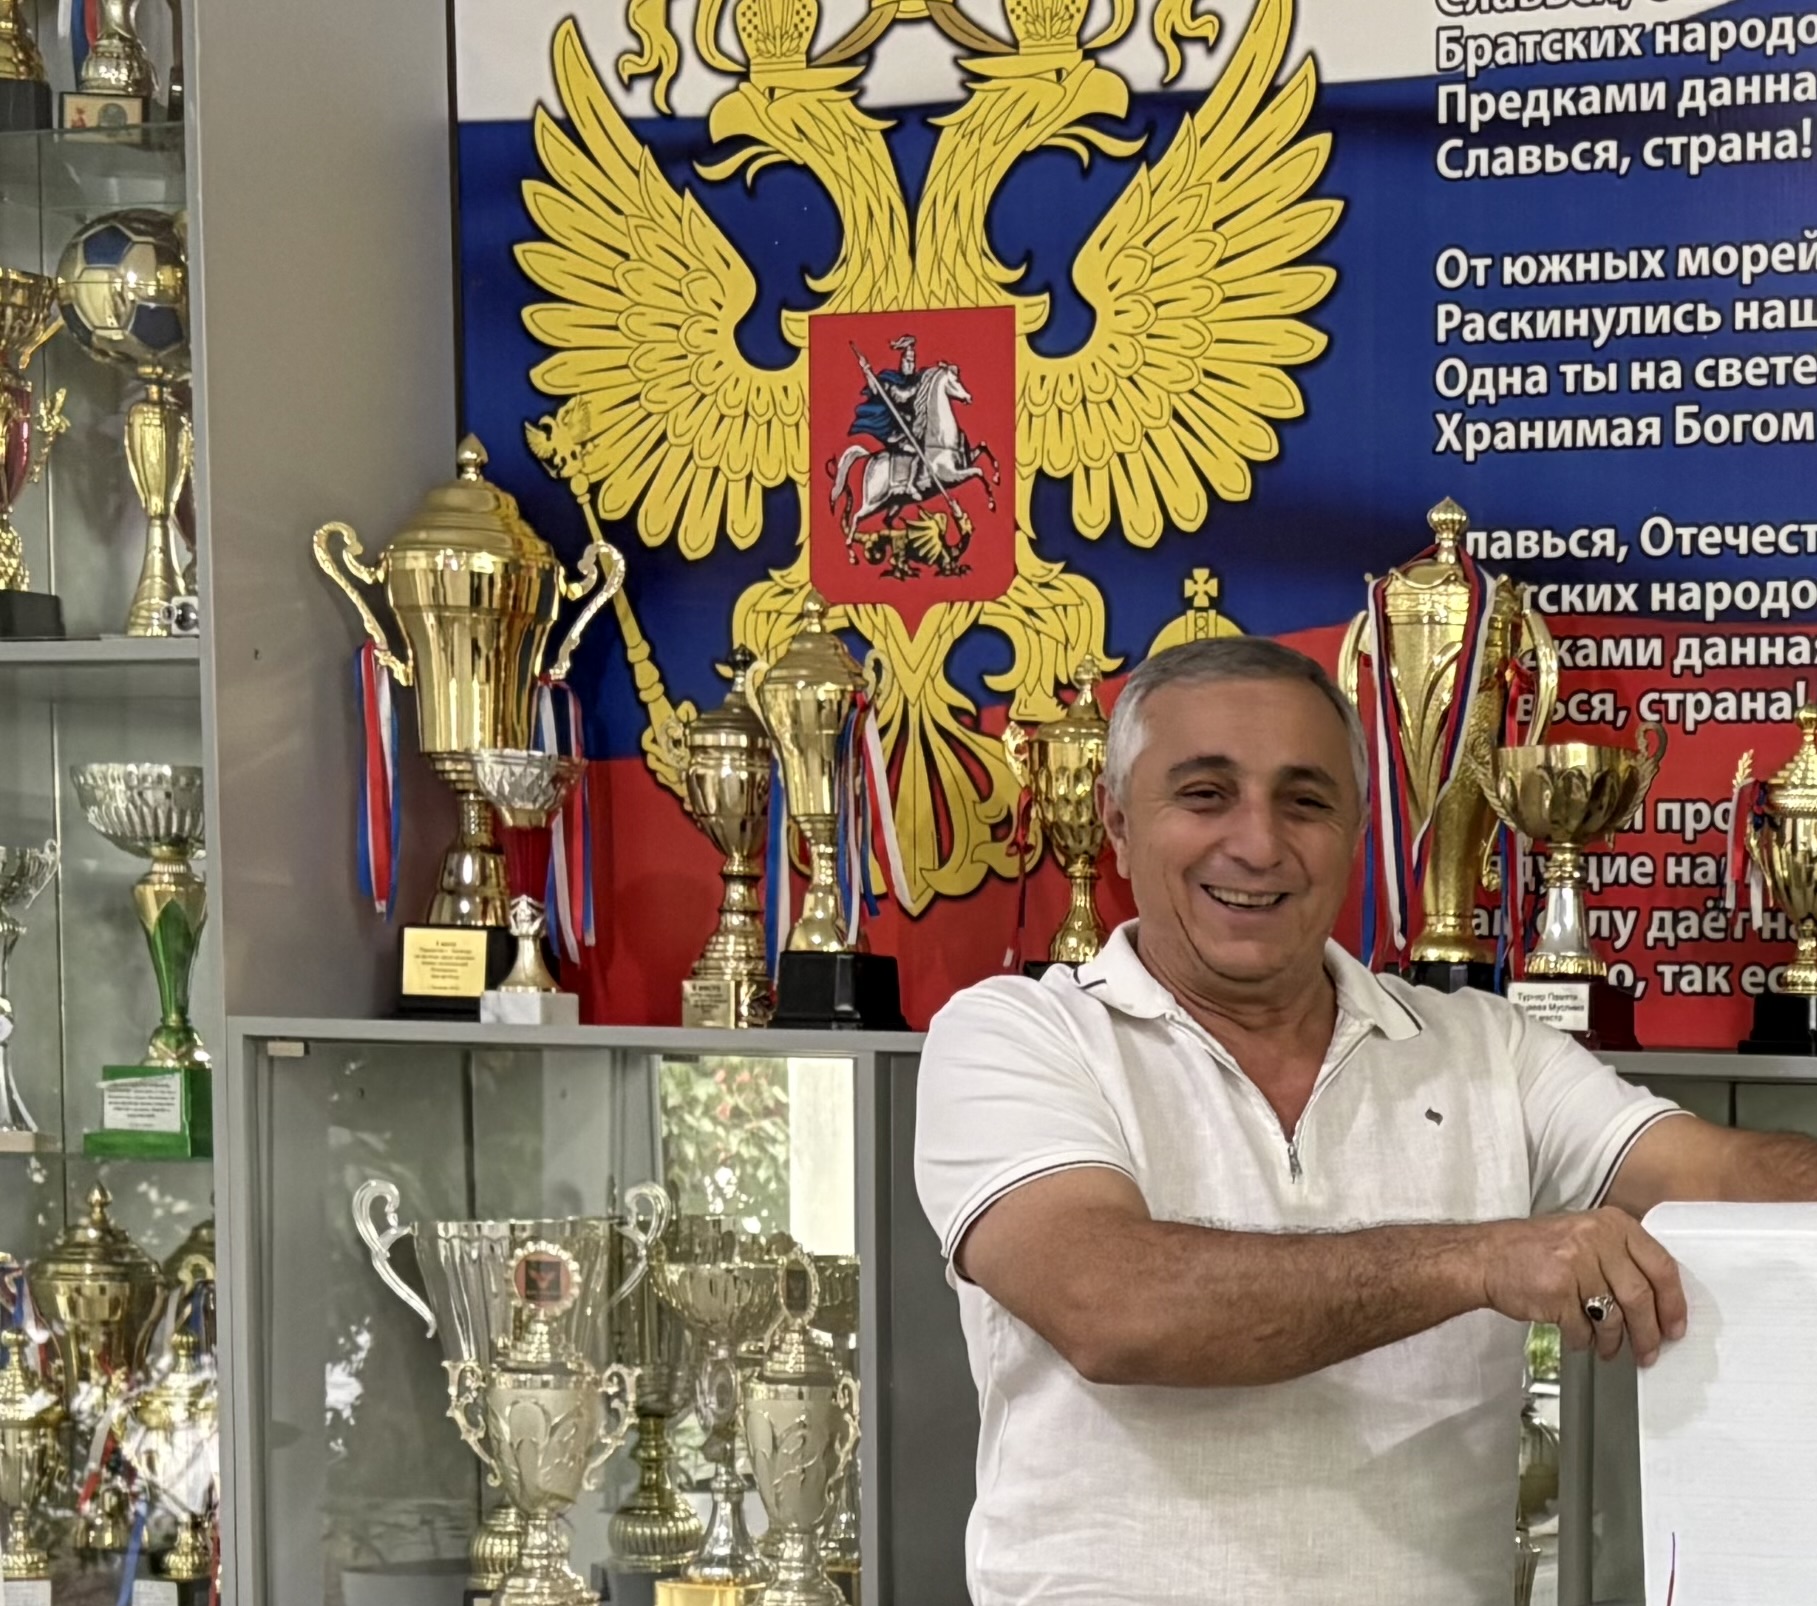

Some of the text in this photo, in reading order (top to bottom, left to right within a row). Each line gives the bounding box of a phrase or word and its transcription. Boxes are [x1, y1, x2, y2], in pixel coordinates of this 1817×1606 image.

[1438, 26, 1643, 78] Братских
[1438, 81, 1666, 133] Предками
[1436, 139, 1631, 178] Славься,
[1642, 118, 1812, 175] страна!
[1435, 248, 1492, 289] От
[1502, 248, 1666, 287] южных
[1436, 302, 1721, 348] Раскинулись
[1435, 358, 1548, 405] Одна
[1559, 362, 1618, 393] ты
[1631, 360, 1682, 391] на
[1434, 412, 1661, 462] Хранимая
[1675, 405, 1815, 446] Богом
[1466, 528, 1628, 563] лавься,
[1523, 582, 1639, 613] тских
[1524, 637, 1661, 667] ками
[1656, 964, 1731, 995] так
